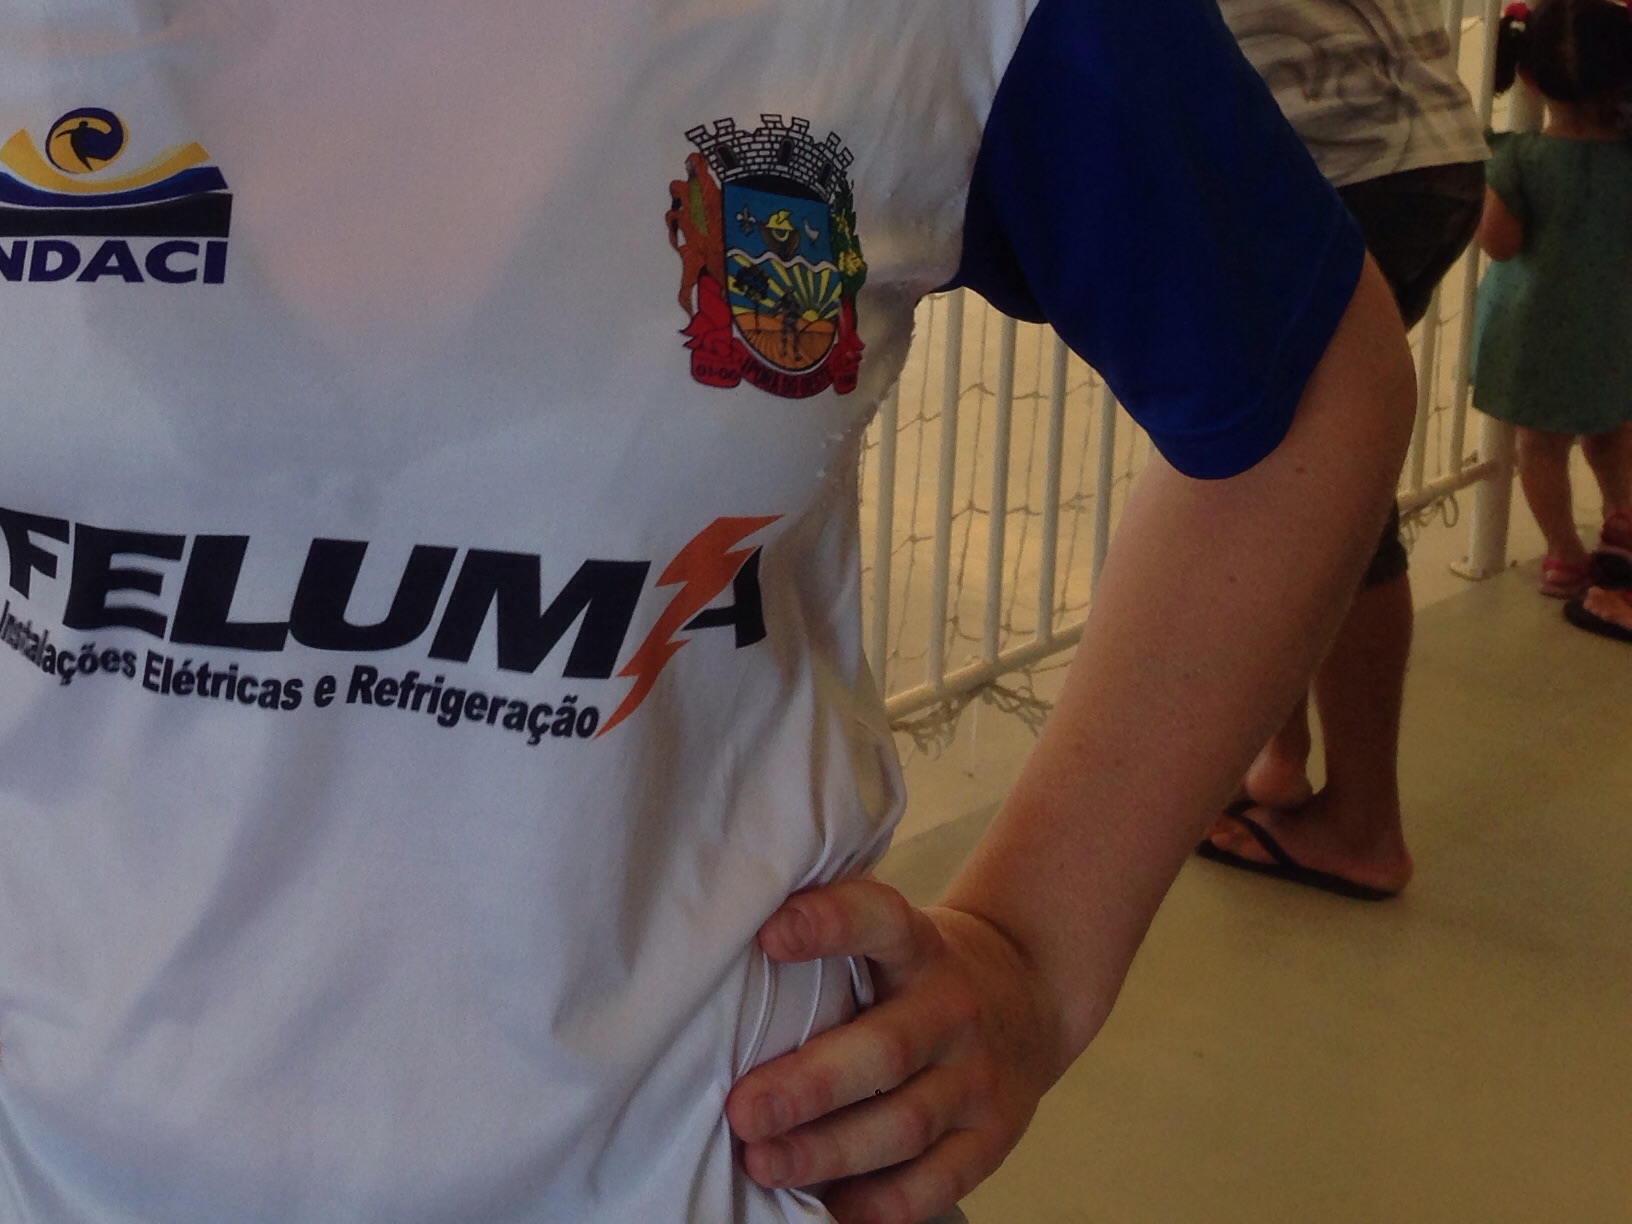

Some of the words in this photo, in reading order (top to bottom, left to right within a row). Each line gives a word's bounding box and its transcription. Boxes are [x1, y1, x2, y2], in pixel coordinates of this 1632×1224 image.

[142, 648, 305, 711] Elétricas
[313, 674, 337, 708] e
[345, 664, 600, 746] Refrigeração
